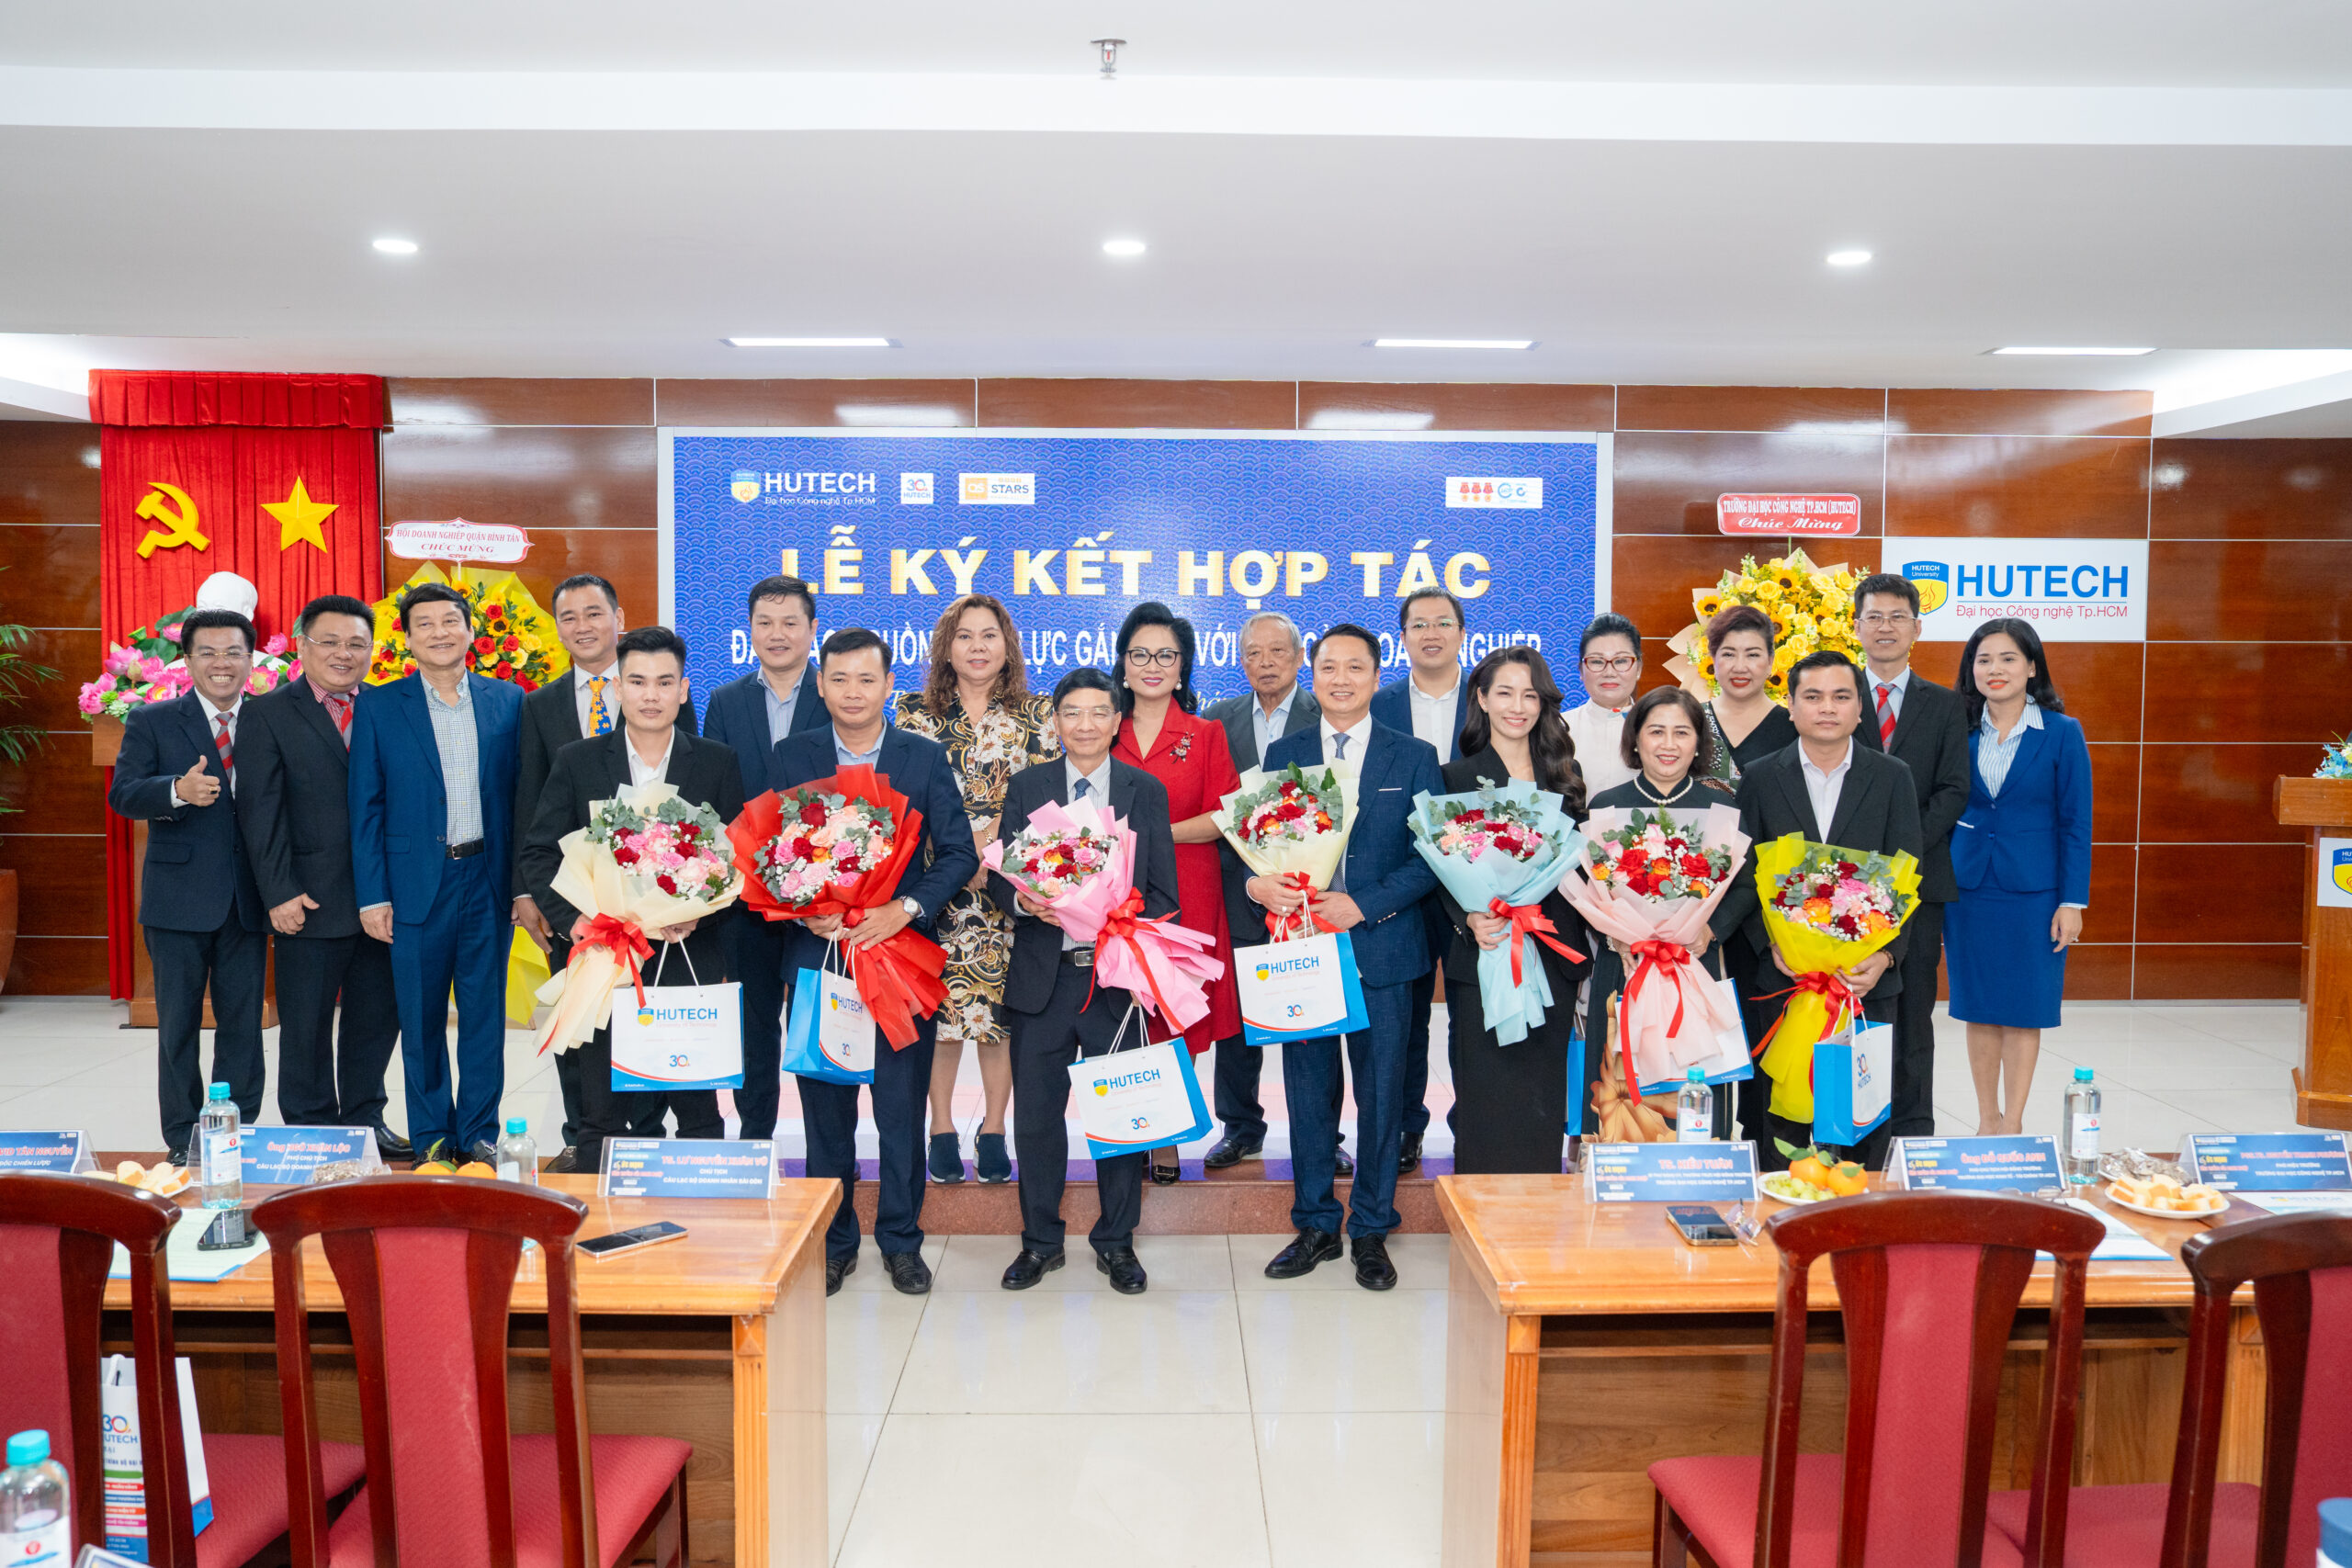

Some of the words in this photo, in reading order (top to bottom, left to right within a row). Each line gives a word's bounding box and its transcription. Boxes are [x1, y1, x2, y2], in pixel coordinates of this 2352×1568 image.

[765, 473, 876, 493] HUTECH
[991, 484, 1030, 494] STARS
[843, 497, 876, 505] Tp.HCM
[1759, 501, 1772, 516] HỌC
[1772, 497, 1789, 513] CÔNG
[1807, 501, 1827, 513] TP.HCM
[1828, 500, 1856, 514] (HUTECH)
[1738, 517, 1784, 528] Chúc
[1787, 518, 1843, 531] Mừng
[411, 530, 437, 539] DOANH
[782, 525, 864, 594] LỄ
[890, 536, 989, 594] KÝ
[1013, 531, 1152, 595] KẾT
[1178, 549, 1329, 610] HỢP
[1351, 539, 1490, 599] TÁC
[1957, 565, 2128, 598] HUTECH
[1956, 604, 1976, 619] Đại
[1980, 605, 2003, 619] học
[2007, 605, 2040, 619] Công
[2043, 605, 2074, 619] nghệ
[2077, 605, 2128, 619] Tp.HCM
[1194, 623, 1237, 667] VỚI
[1271, 956, 1319, 974] HUTECH
[838, 995, 863, 1014] HUTECH
[1286, 1004, 1303, 1017] 30
[657, 1008, 718, 1020] HUTECH
[669, 1055, 688, 1066] 30
[1109, 1068, 1160, 1089] HUTECH
[1131, 1117, 1148, 1130] 30
[38, 1144, 74, 1156] NGUYỄN
[266, 1141, 285, 1153] Ông
[1658, 1159, 1676, 1169] TS.
[104, 1434, 138, 1443] UTECH
